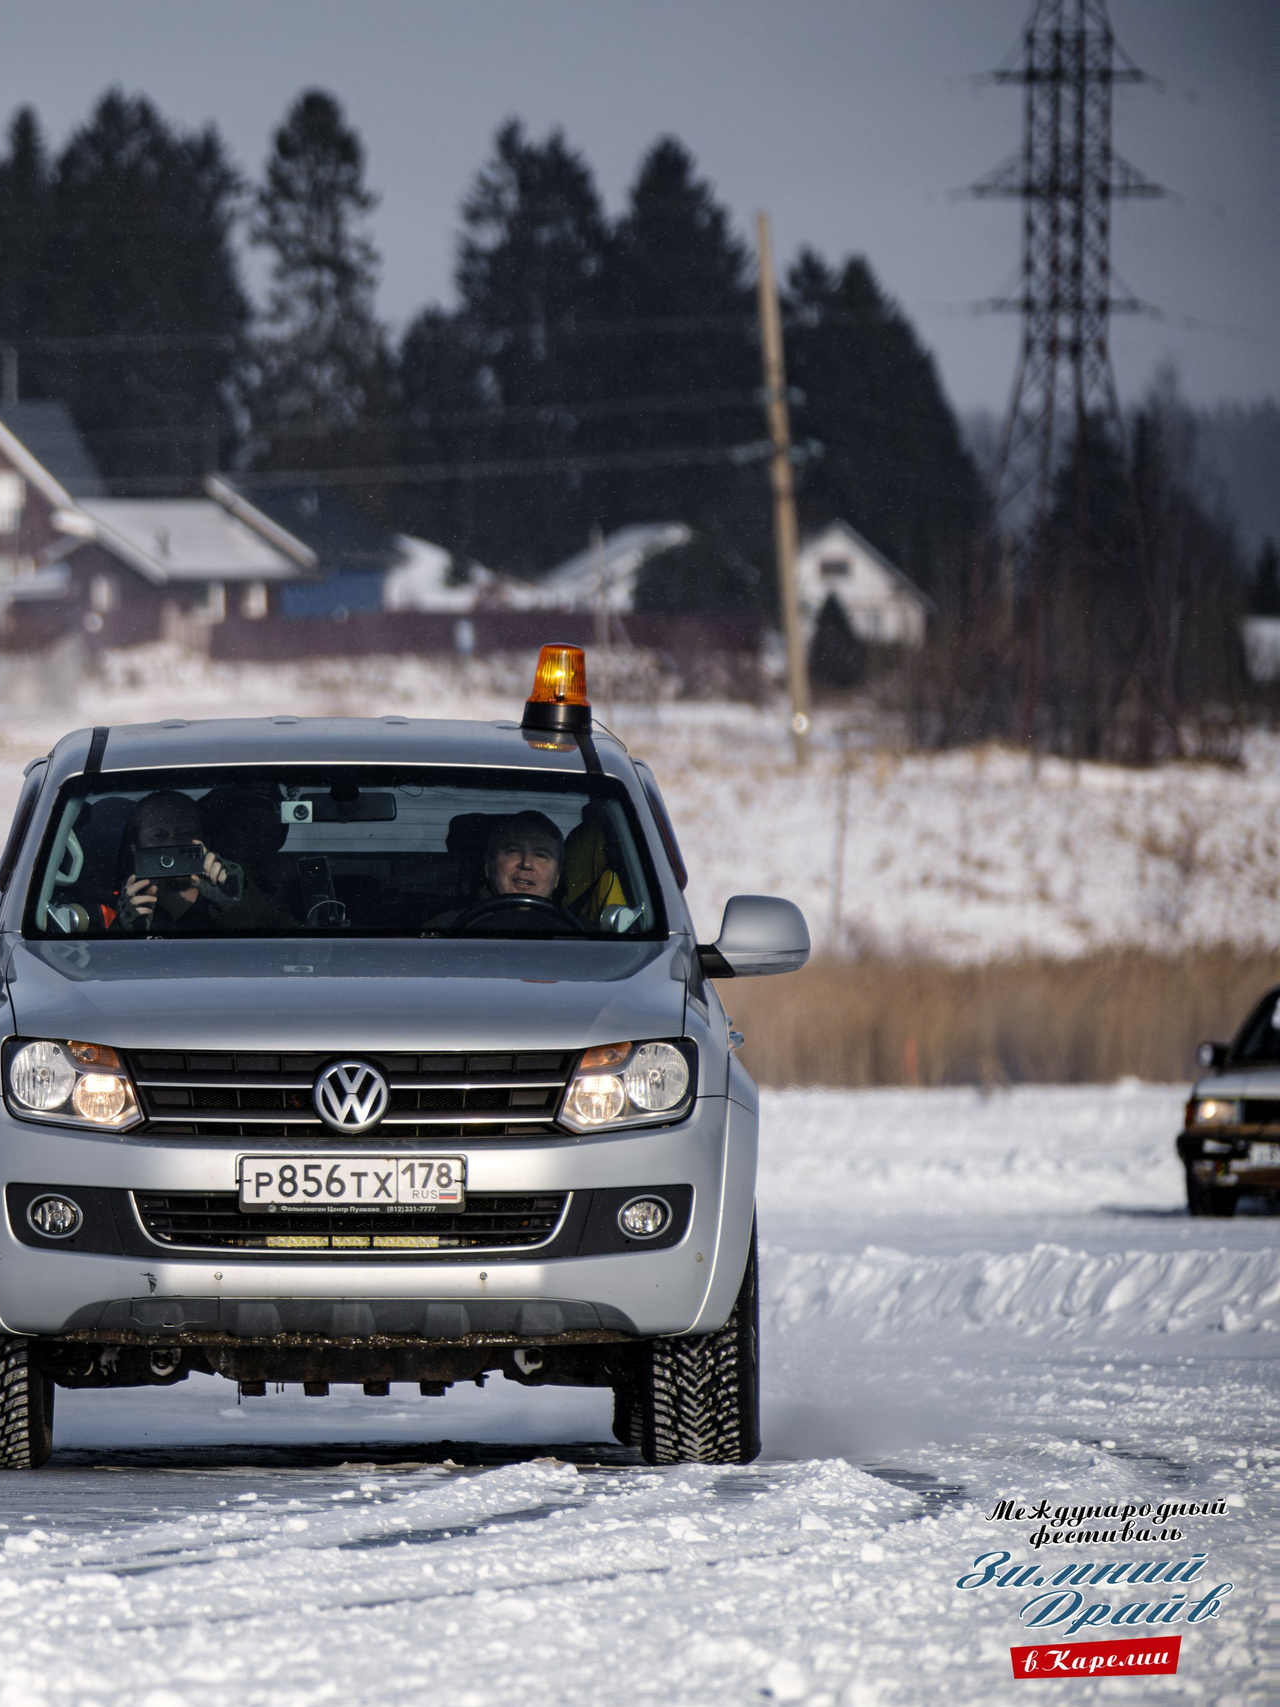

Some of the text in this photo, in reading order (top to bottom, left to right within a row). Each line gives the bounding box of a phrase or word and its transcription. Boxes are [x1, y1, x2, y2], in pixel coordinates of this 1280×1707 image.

[401, 1162, 453, 1189] 178
[412, 1190, 437, 1199] RUS
[327, 1206, 349, 1214] Центр
[350, 1206, 380, 1214] Пулково
